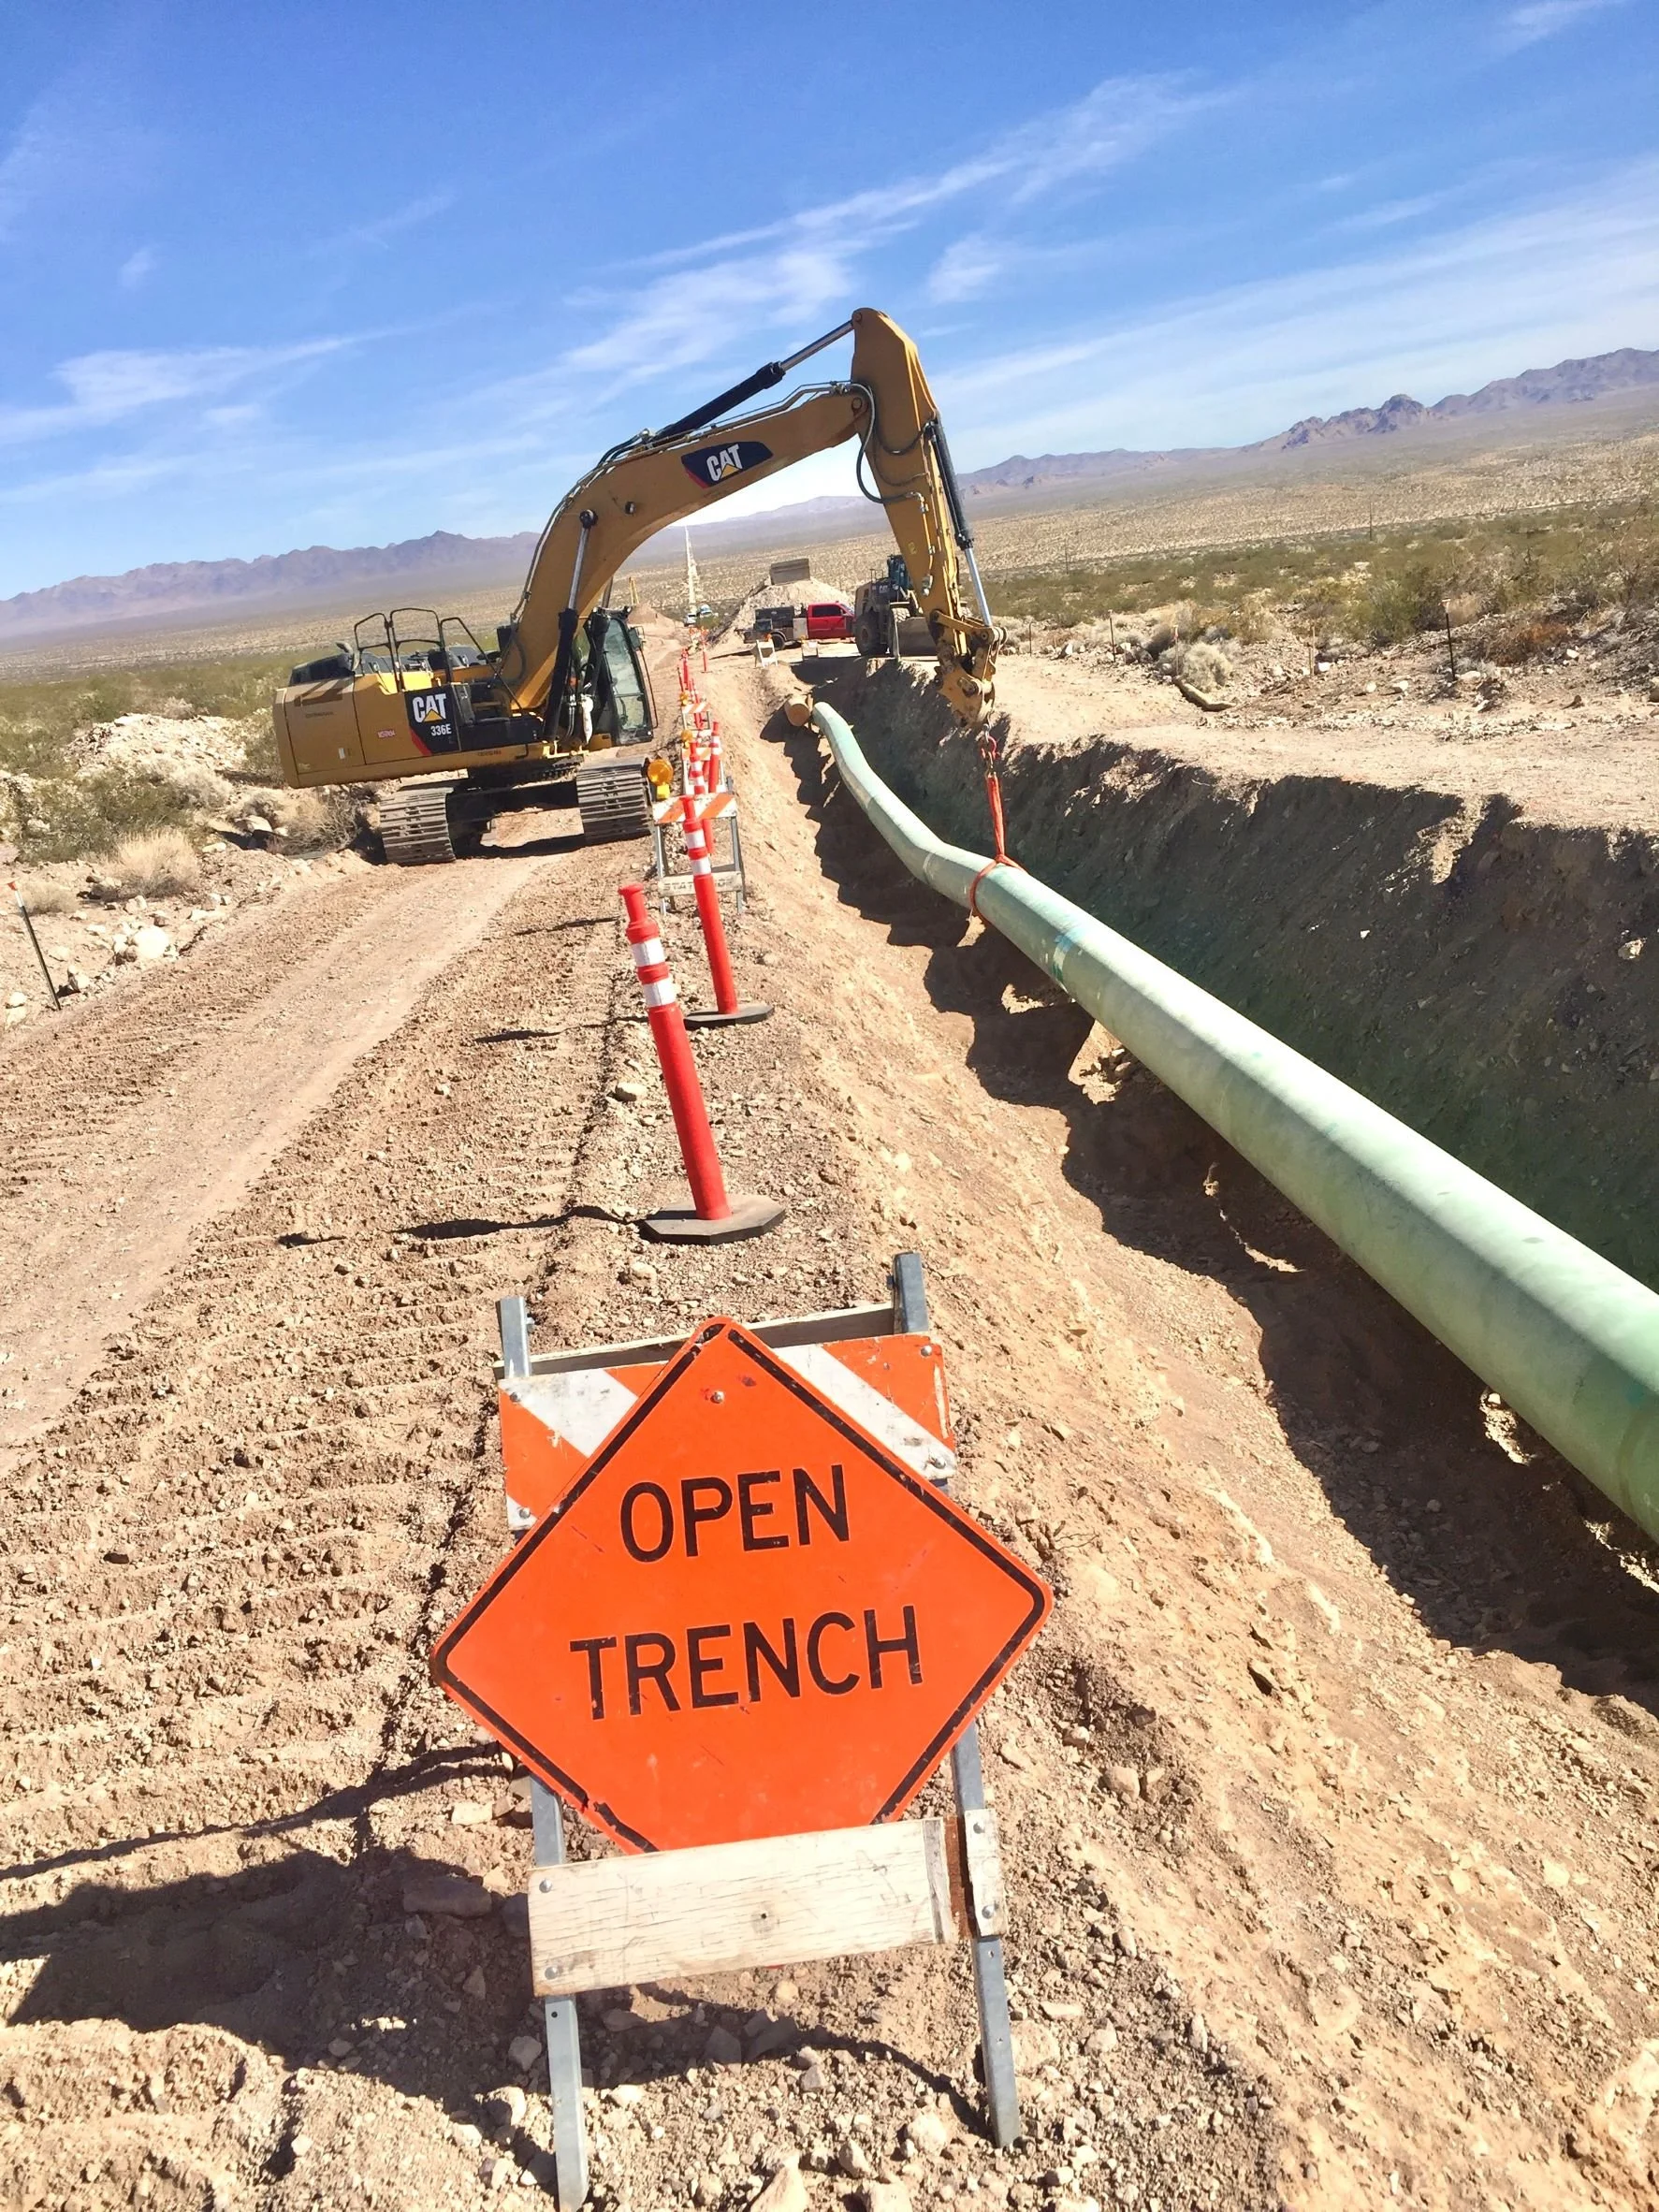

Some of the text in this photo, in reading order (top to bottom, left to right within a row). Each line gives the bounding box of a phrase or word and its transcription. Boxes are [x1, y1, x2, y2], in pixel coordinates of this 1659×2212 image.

[706, 444, 743, 481] CAT
[412, 693, 447, 723] CAT
[430, 723, 452, 736] 336E
[619, 1464, 850, 1563] OPEN
[569, 1605, 924, 1721] TRENCH
